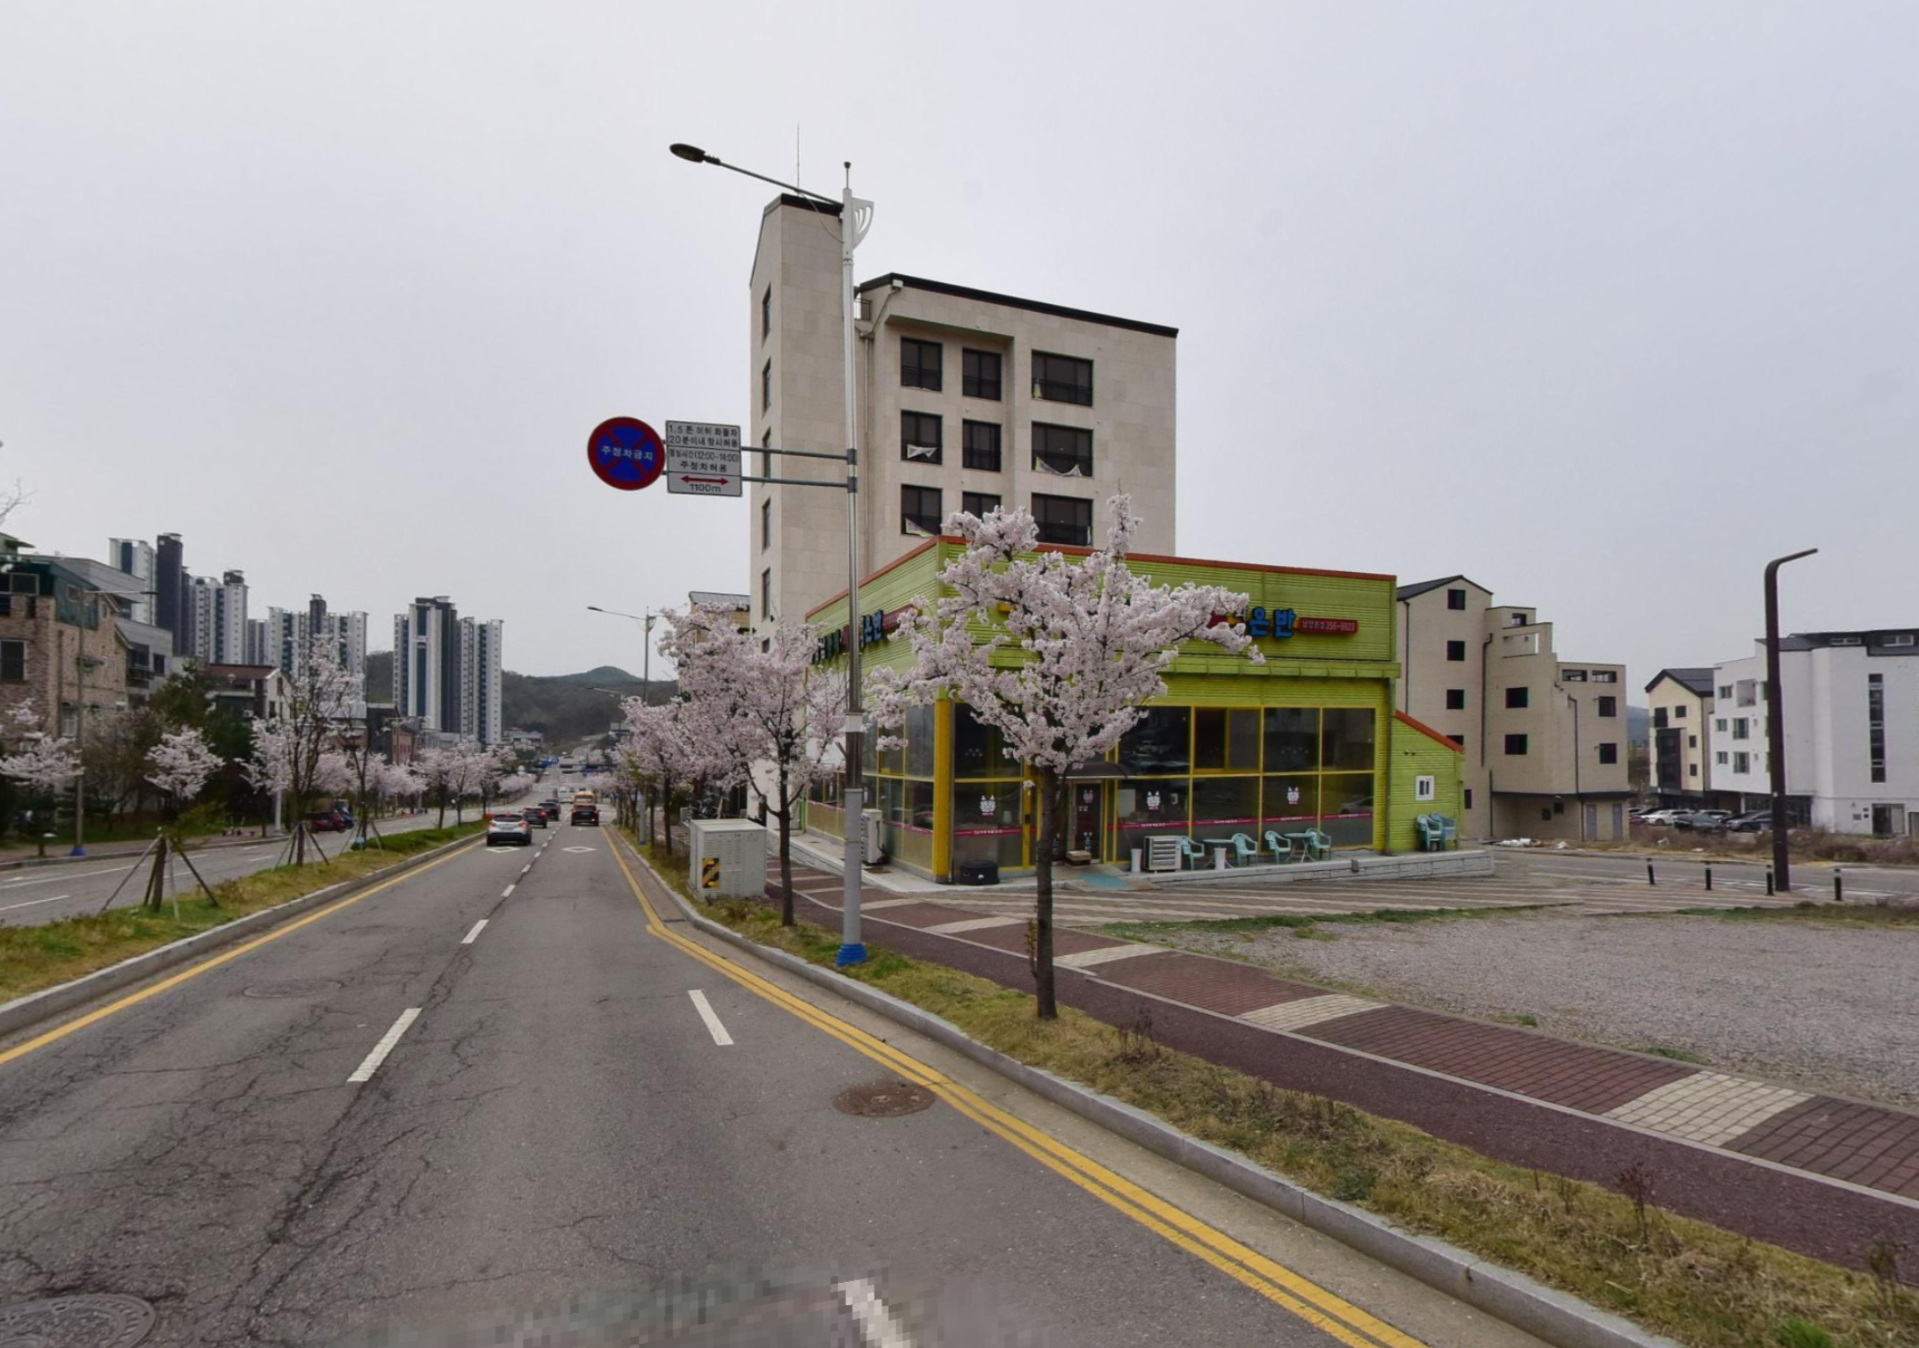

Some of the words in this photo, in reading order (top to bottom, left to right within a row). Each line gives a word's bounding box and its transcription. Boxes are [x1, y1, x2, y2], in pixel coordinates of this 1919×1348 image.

[696, 426, 712, 436] 이하
[715, 427, 738, 438] 화물차
[601, 445, 653, 461] 주정차금지
[680, 461, 727, 473] 주정차허용
[689, 483, 721, 493] 1100m
